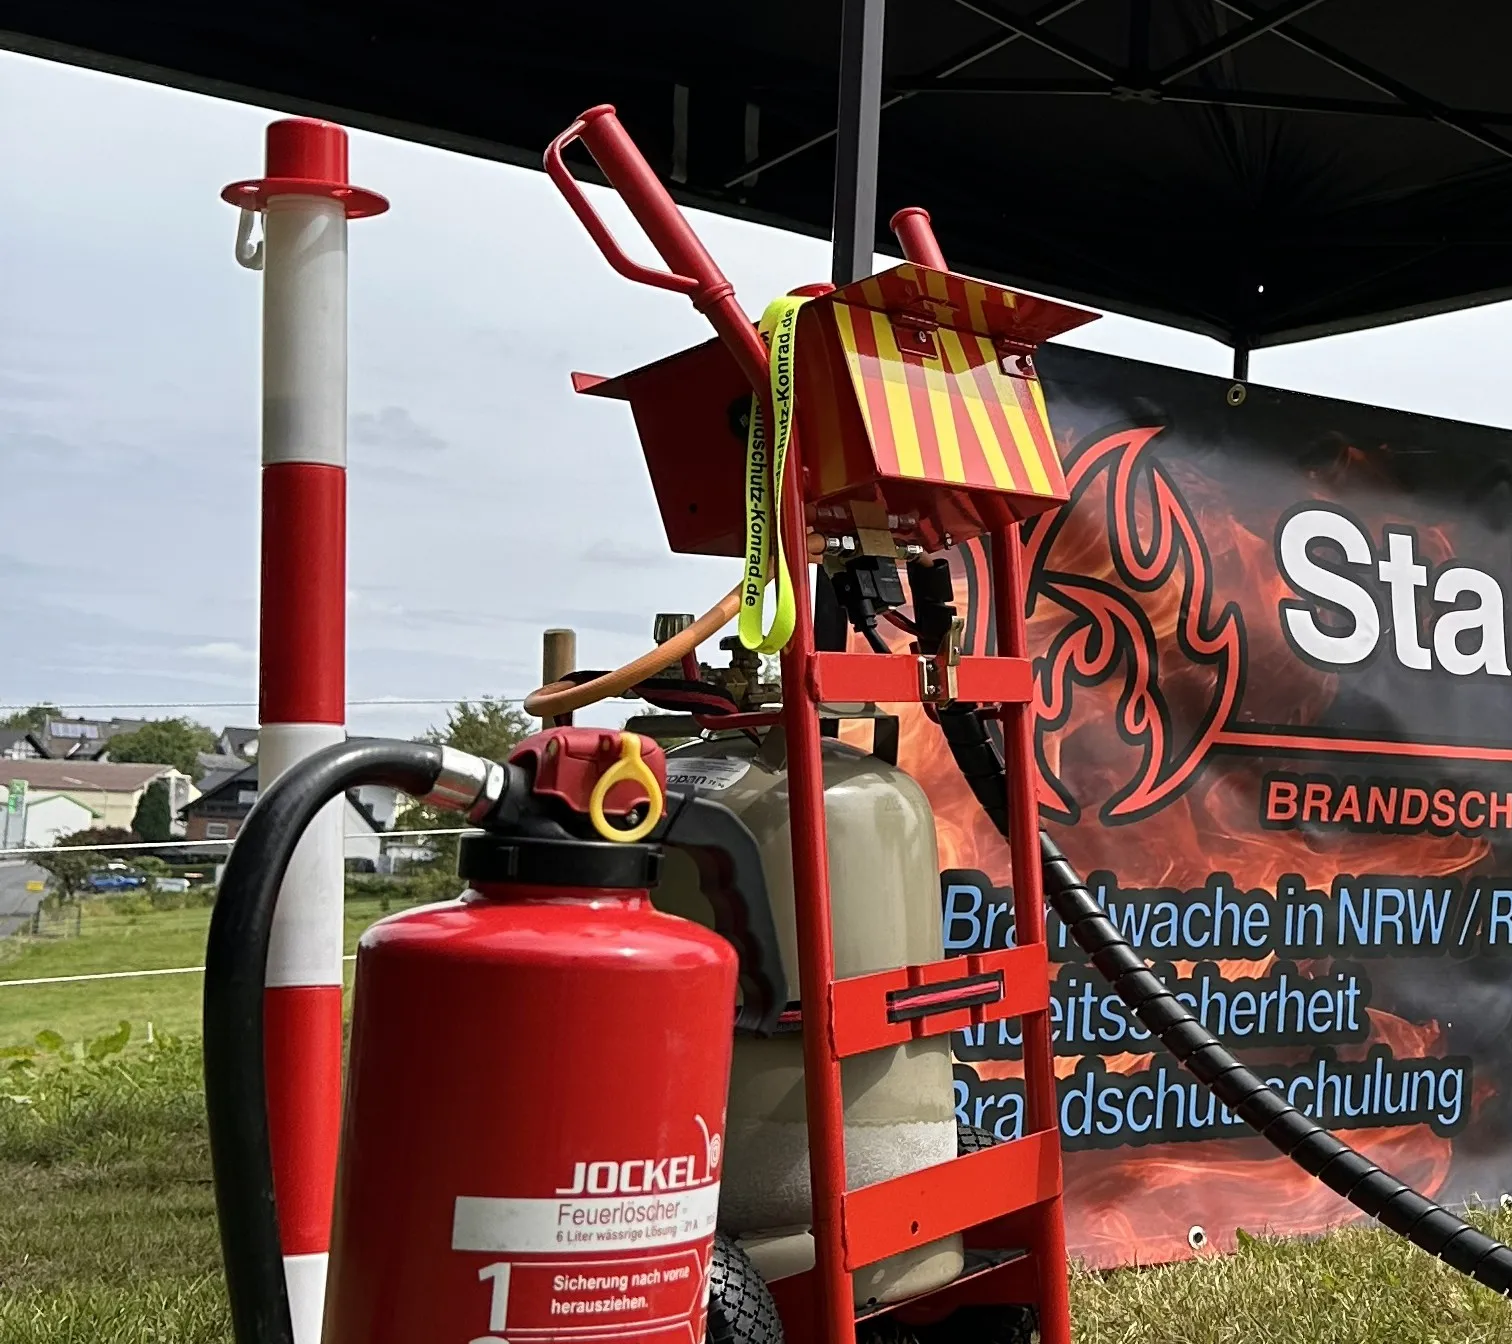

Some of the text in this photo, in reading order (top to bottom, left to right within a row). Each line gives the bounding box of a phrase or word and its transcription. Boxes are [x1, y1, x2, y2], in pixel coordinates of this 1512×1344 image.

[1284, 887, 1324, 946] in
[1337, 888, 1451, 946] NRW
[556, 1155, 701, 1195] JOCKEL
[558, 1199, 681, 1226] Feuerlöscher
[556, 1230, 563, 1242] 6
[567, 1230, 594, 1242] Liter
[645, 1225, 678, 1238] Lösung
[553, 1265, 690, 1293] Sicherung nach vorne
[477, 1261, 512, 1333] 1
[551, 1295, 649, 1315] herausziehen.
